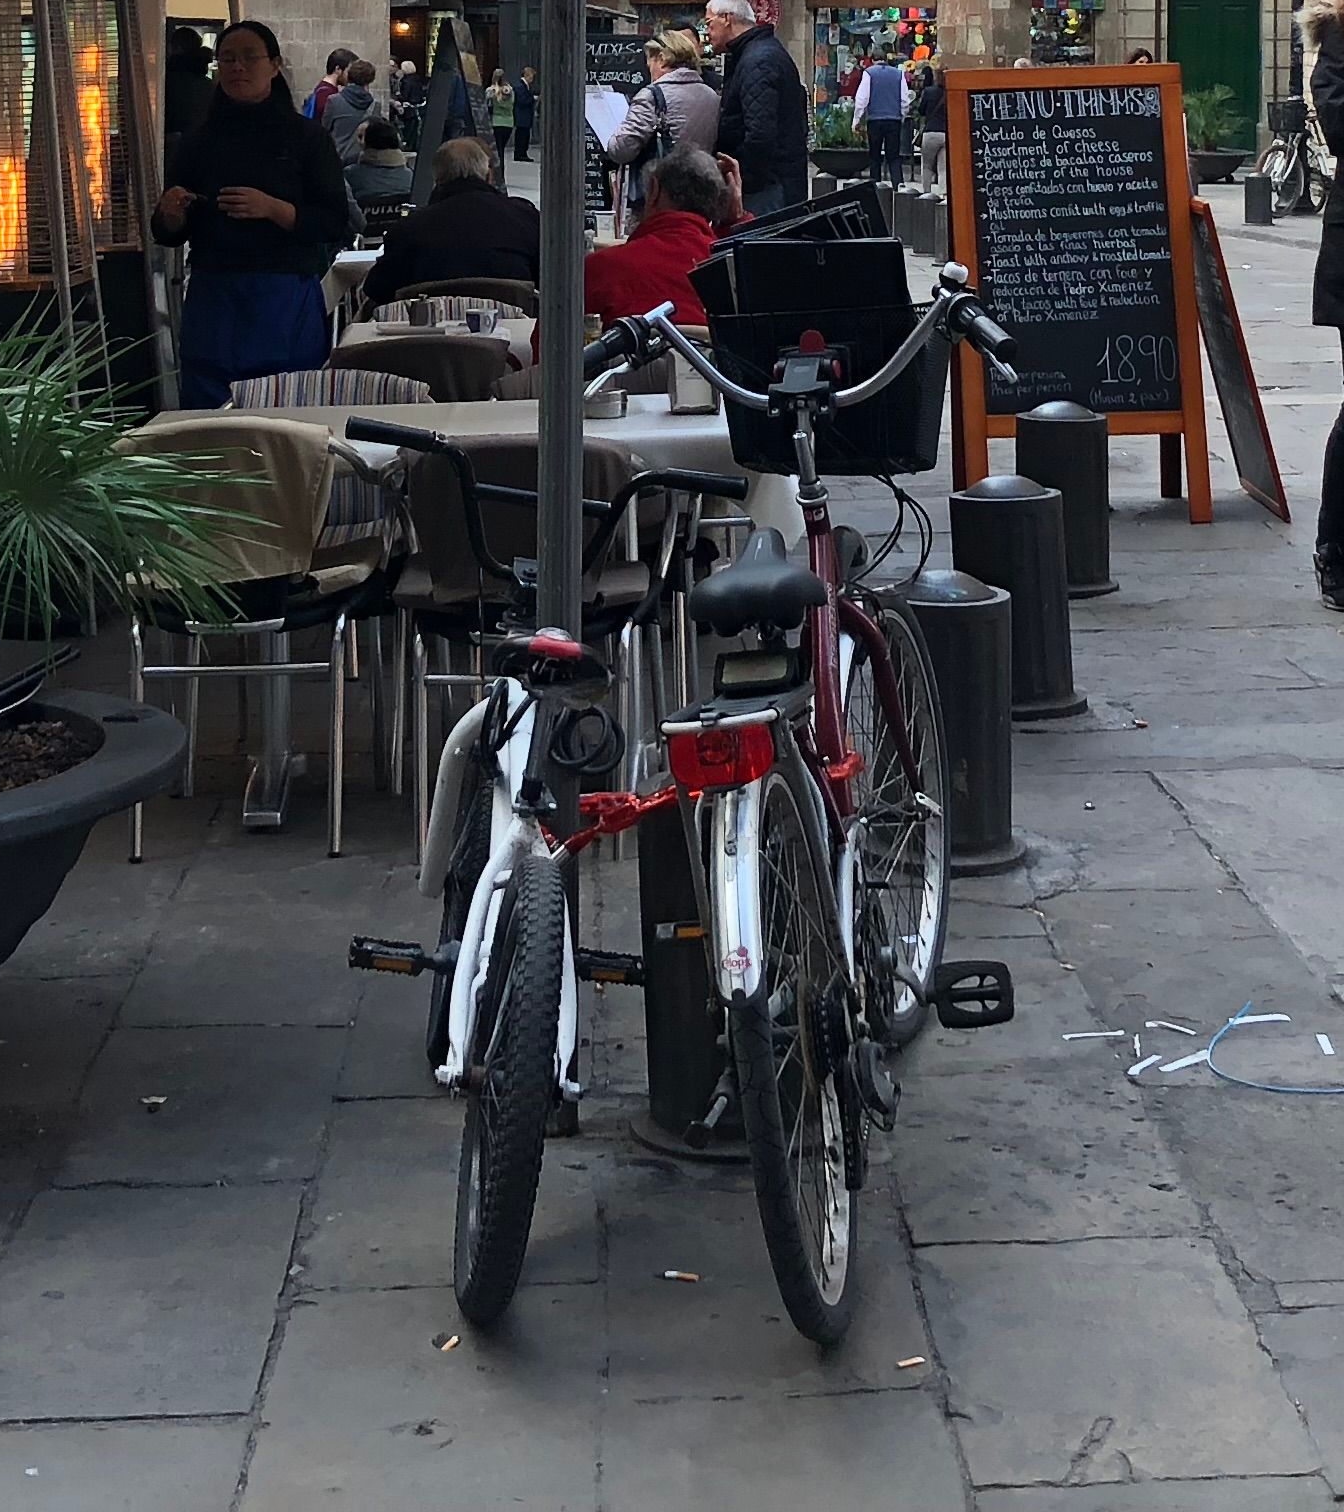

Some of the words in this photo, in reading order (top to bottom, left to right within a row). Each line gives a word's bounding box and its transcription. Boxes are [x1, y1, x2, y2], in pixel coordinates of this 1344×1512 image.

[982, 125, 1024, 143] Surtido
[1032, 125, 1046, 139] de
[1052, 125, 1097, 139] Quesos
[984, 142, 1049, 158] Assortment
[1056, 141, 1070, 154] of
[1074, 140, 1120, 153] cheese
[1040, 155, 1053, 168] de
[1055, 153, 1104, 167] bacalao
[1108, 151, 1153, 163] caseros
[984, 170, 1004, 181] Cod
[1053, 167, 1066, 179] of
[1069, 166, 1088, 178] the
[1096, 165, 1134, 177] house
[1066, 182, 1086, 194] con
[987, 196, 1000, 208] de
[989, 206, 1047, 221] Mushrooms
[1108, 228, 1128, 239] con
[1025, 244, 1034, 253] a
[1038, 242, 1055, 252] las
[1093, 239, 1136, 250] hierbas
[990, 254, 1020, 268] Toast
[1024, 252, 1047, 267] with
[1050, 250, 1089, 265] anchovy
[1100, 247, 1138, 262] roasted
[991, 268, 1020, 284] Tacos
[1024, 268, 1038, 284] de
[1042, 267, 1084, 284] ternera
[1090, 267, 1111, 280] con
[1049, 283, 1060, 296] de
[1064, 282, 1095, 295] Pedro
[1098, 280, 1154, 293] Ximenez
[1022, 297, 1051, 310] tacos
[997, 312, 1009, 323] of
[1013, 311, 1042, 323] Pedro
[1045, 309, 1099, 321] Ximenez
[1128, 392, 1137, 405] 2
